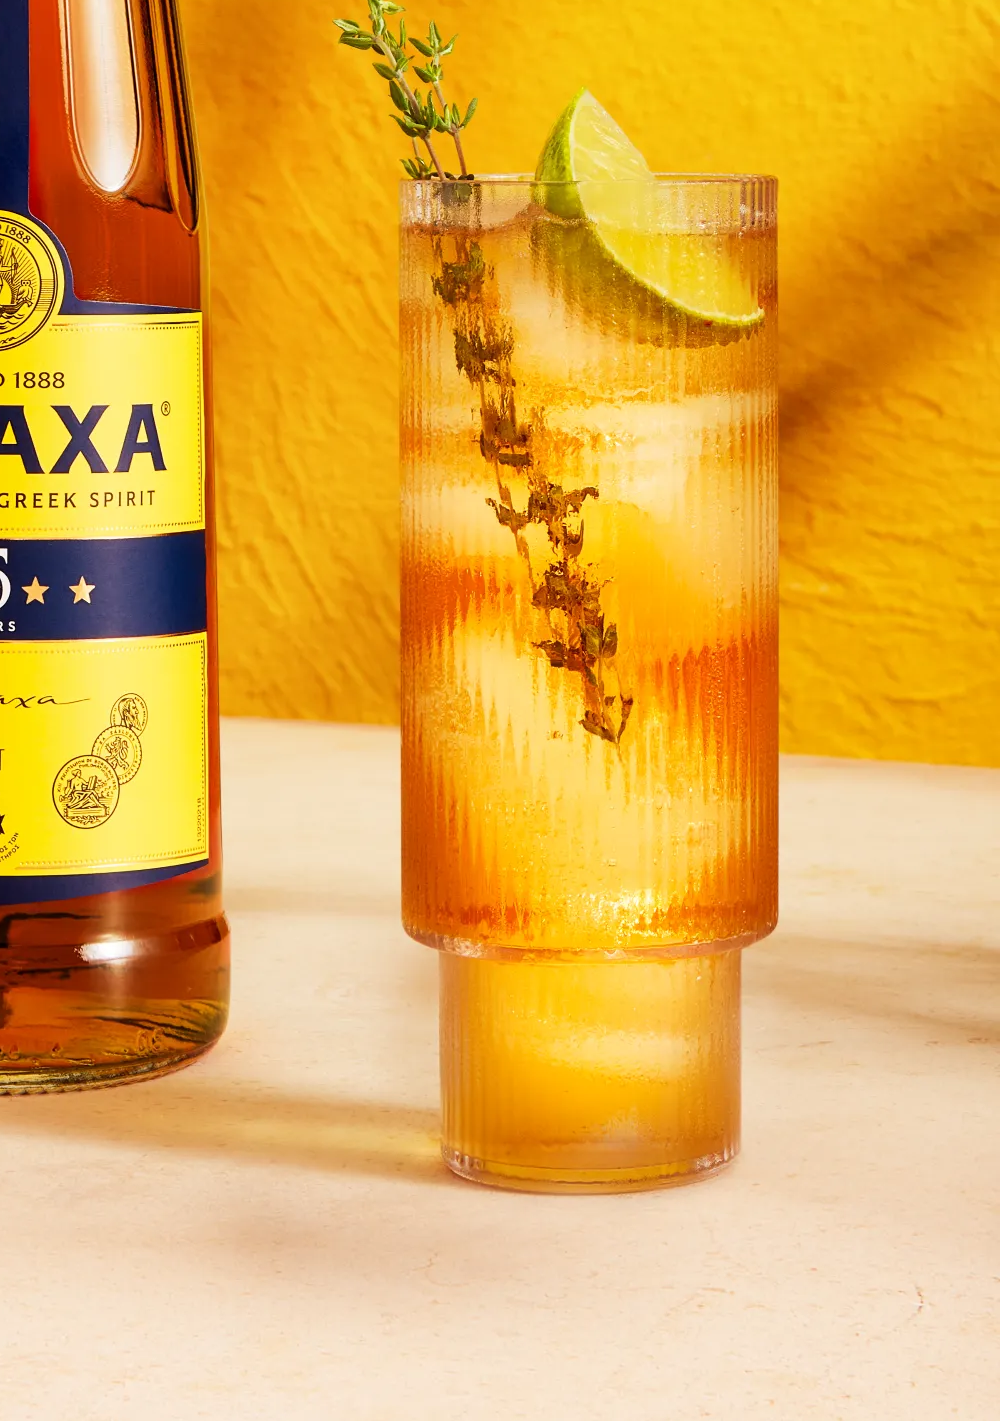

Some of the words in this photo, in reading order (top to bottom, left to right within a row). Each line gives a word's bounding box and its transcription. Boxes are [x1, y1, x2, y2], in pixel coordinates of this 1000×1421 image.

[5, 224, 32, 245] 1888
[13, 371, 65, 389] 1888
[89, 489, 157, 508] SPIRIT
